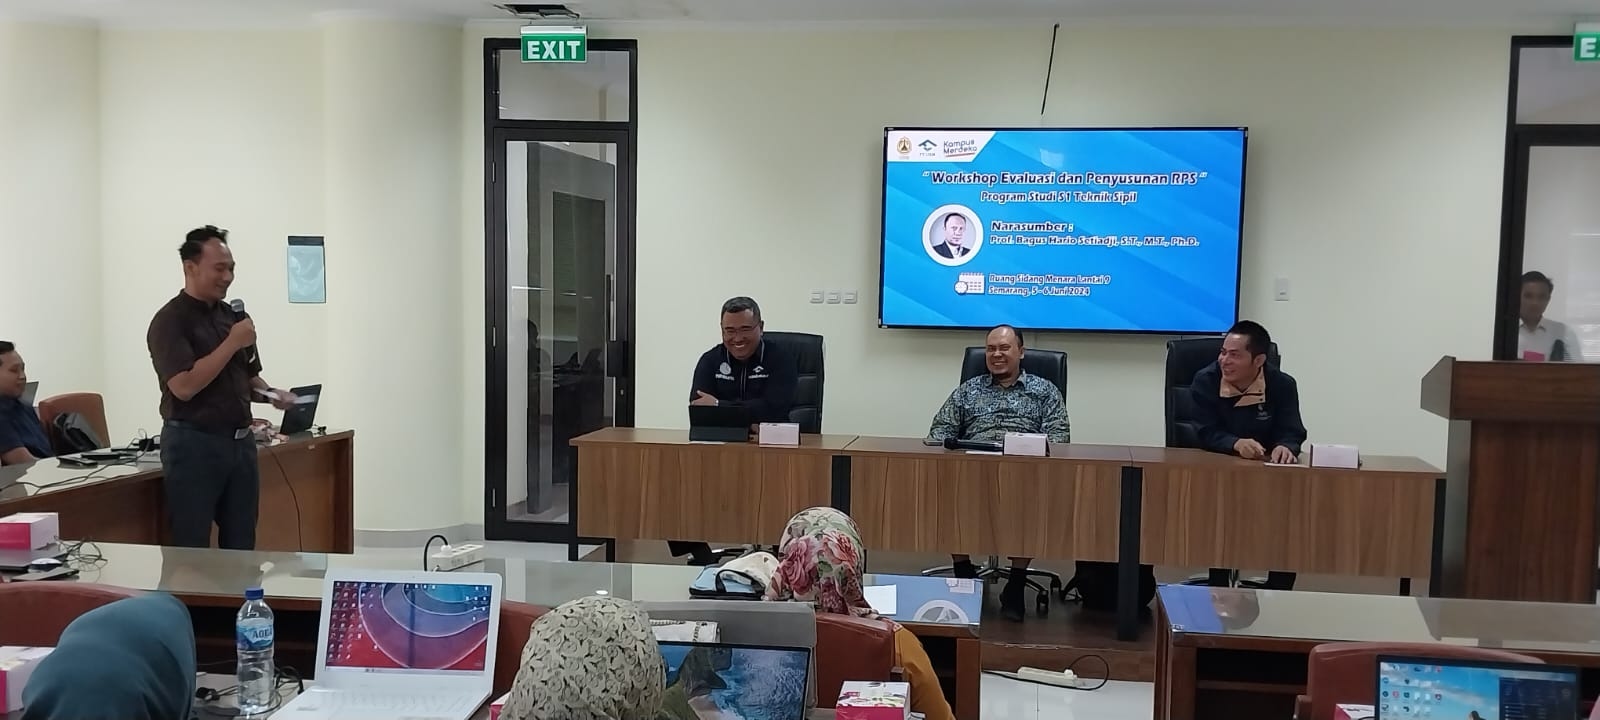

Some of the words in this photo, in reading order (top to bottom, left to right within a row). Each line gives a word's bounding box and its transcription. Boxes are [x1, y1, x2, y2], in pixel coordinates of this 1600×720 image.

[527, 40, 581, 60] EXIT
[944, 139, 975, 148] Kampus
[944, 146, 977, 154] Merdeka
[931, 172, 998, 187] Workshop
[1001, 172, 1055, 184] Evaluasi
[1058, 172, 1083, 185] dan
[1086, 172, 1169, 187] Penyusunan
[1171, 172, 1197, 185] RPS
[981, 191, 1027, 203] Program
[1029, 191, 1056, 202] Studi
[1058, 191, 1071, 202] S1
[1074, 191, 1112, 202] Teknik
[1113, 191, 1137, 204] Sipil
[991, 221, 1067, 232] Narasumber
[990, 235, 1014, 245] Prof.
[1016, 236, 1046, 247] Bagus
[1048, 236, 1077, 246] Hario
[1078, 236, 1119, 247] Setiadji,
[1120, 237, 1143, 247] S.T.,
[1144, 237, 1170, 247] M.T.,
[1171, 237, 1200, 247] Ph.D.
[989, 273, 1015, 285] Ruang
[1016, 273, 1044, 286] Sidang
[1045, 274, 1076, 285] Menara
[1077, 275, 1103, 285] Lantai
[1103, 275, 1111, 285] 9
[989, 286, 1031, 297] Semarang,
[1049, 286, 1068, 296] Juni
[1068, 287, 1090, 296] 2024
